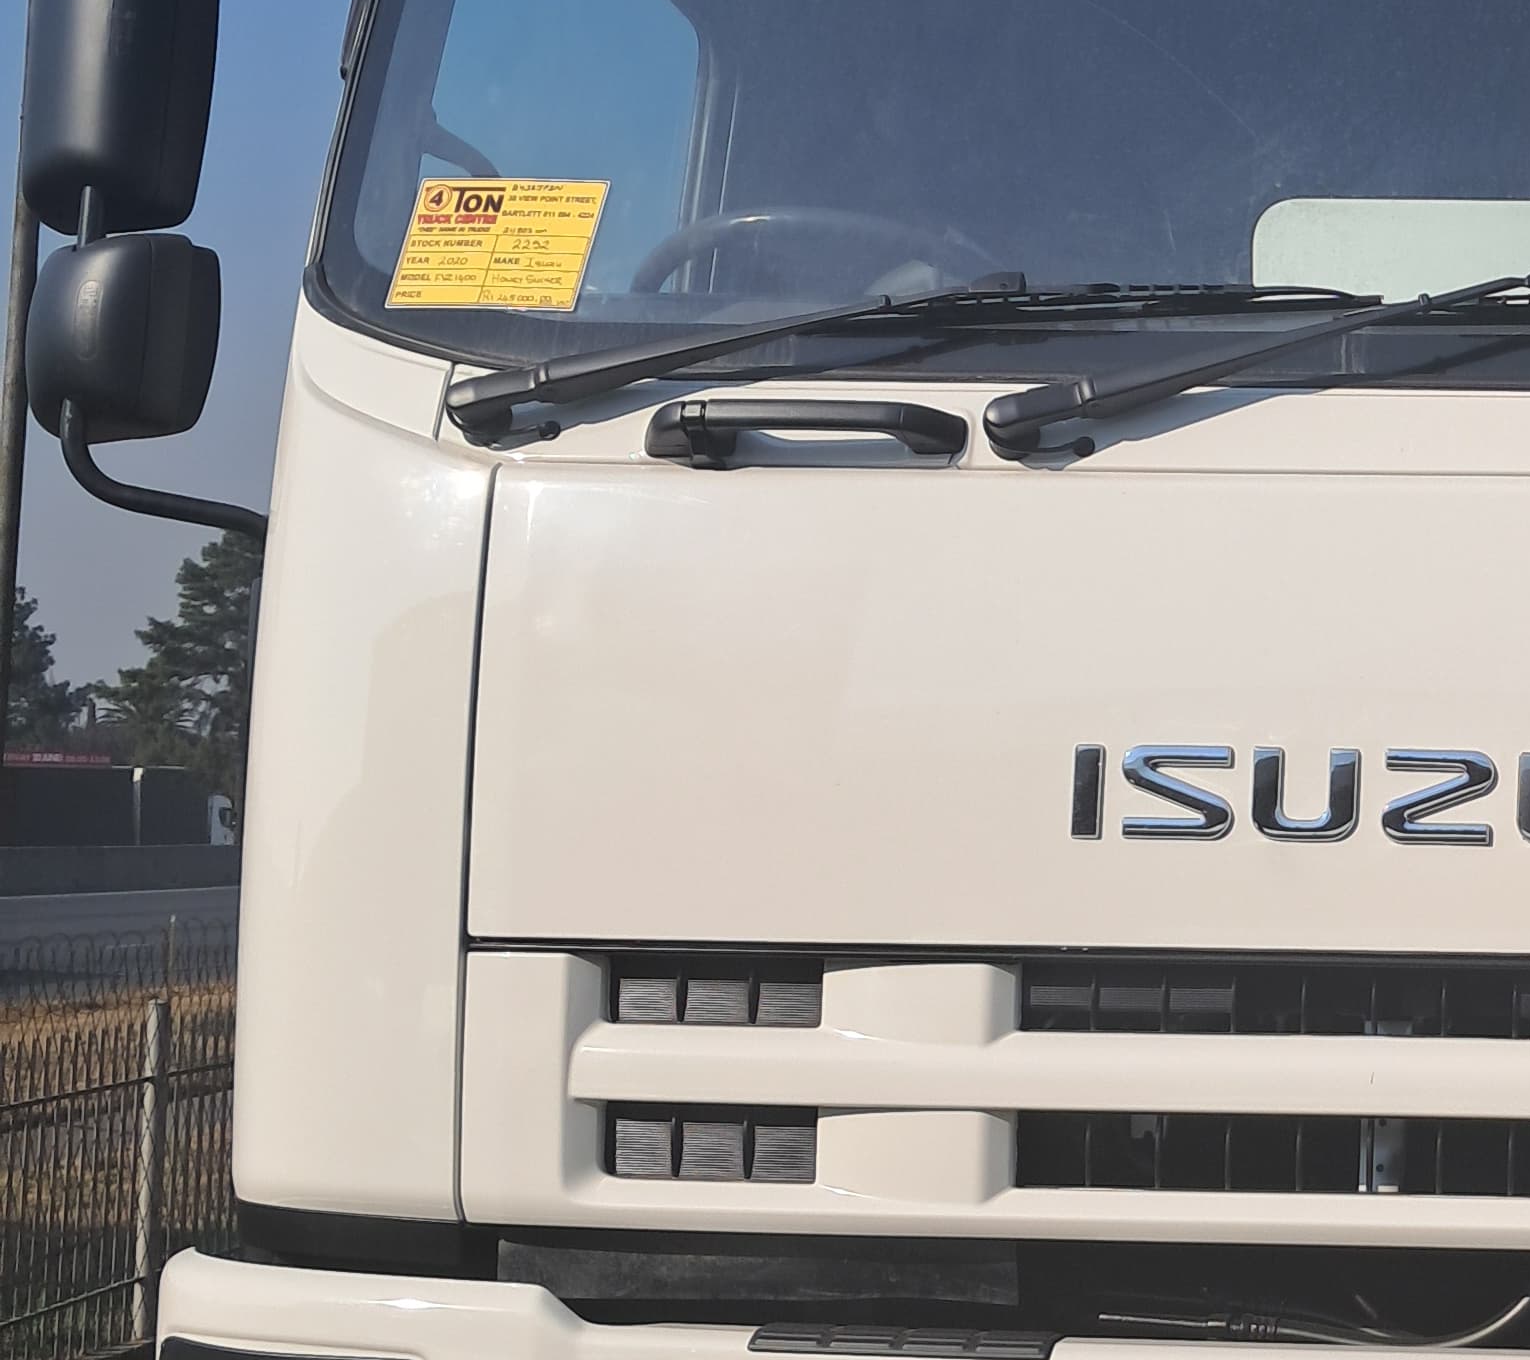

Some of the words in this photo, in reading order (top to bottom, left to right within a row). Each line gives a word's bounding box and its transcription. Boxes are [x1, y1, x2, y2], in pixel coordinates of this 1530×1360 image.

[428, 189, 444, 206] 4
[452, 186, 506, 213] TON
[418, 214, 453, 224] TRUCK
[454, 214, 498, 224] CENTRE
[410, 240, 441, 248] STOCK
[442, 240, 483, 248] NUMBER
[406, 256, 430, 264] YEAR
[438, 256, 469, 266] 2020
[395, 290, 422, 298] PRICE
